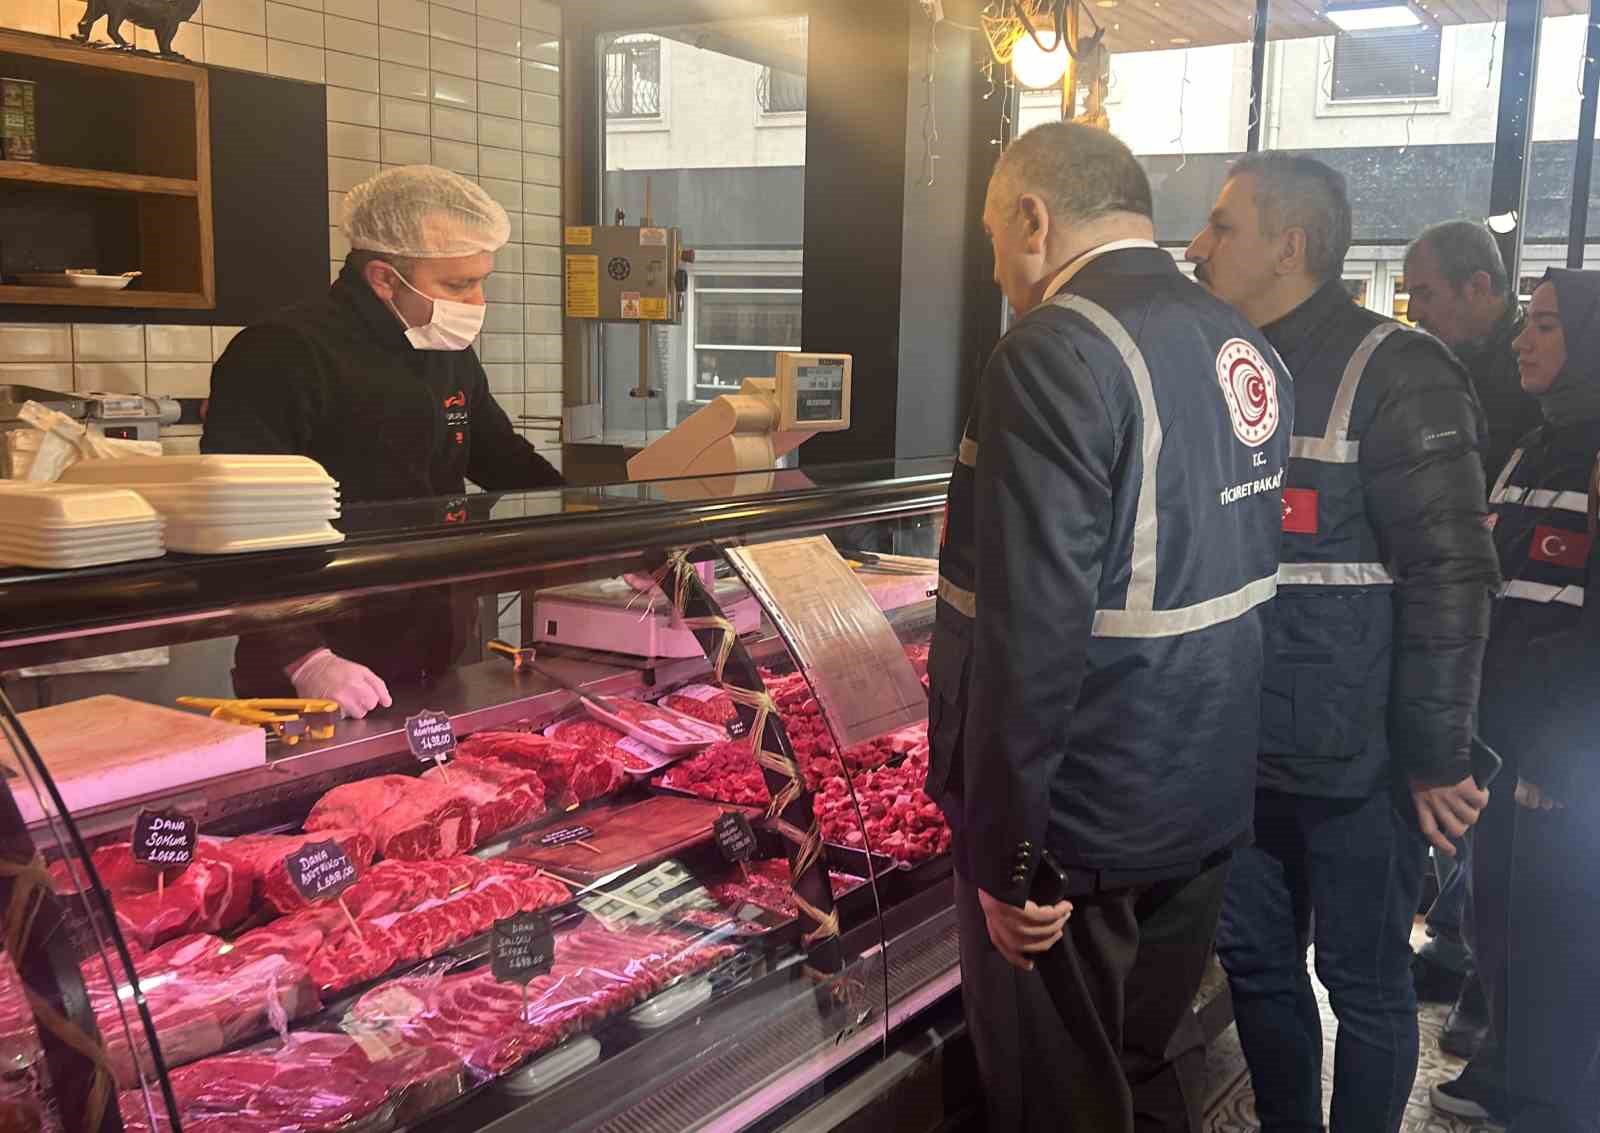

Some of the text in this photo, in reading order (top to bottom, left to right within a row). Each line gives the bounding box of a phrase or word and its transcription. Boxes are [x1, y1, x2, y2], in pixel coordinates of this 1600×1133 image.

[1252, 451, 1267, 466] T.C.
[148, 817, 185, 832] DANA
[299, 849, 329, 872] DANA
